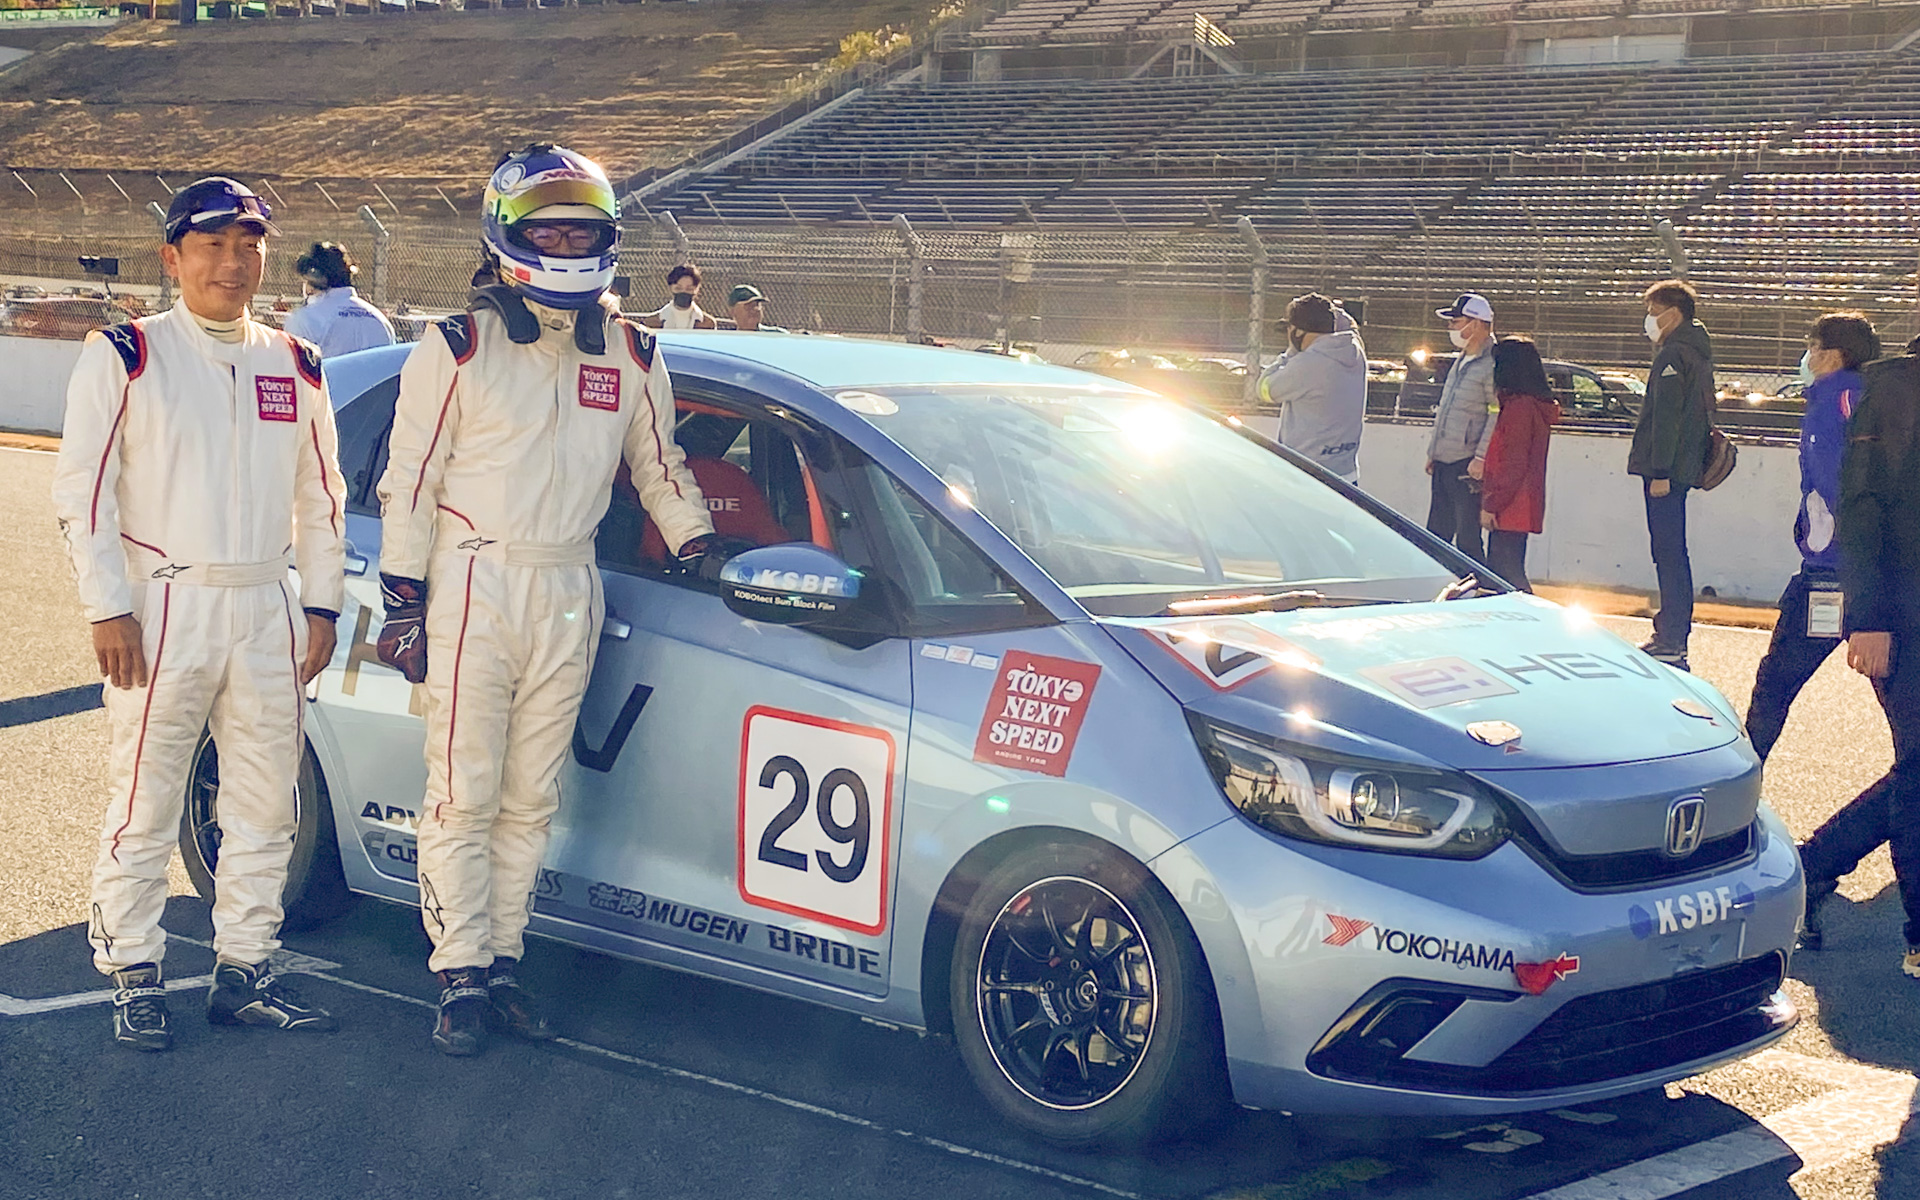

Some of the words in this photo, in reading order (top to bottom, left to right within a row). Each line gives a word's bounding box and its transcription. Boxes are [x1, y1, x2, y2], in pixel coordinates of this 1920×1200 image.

[262, 391, 292, 403] NEXT
[582, 390, 616, 404] SPEED
[585, 380, 615, 393] NEXT
[260, 402, 294, 414] SPEED
[758, 568, 838, 594] KSBF
[775, 596, 792, 606] Sun
[793, 598, 817, 609] Block
[818, 602, 836, 611] Film
[1006, 667, 1084, 702] TOKYO
[1481, 652, 1660, 685] HEV
[1000, 695, 1071, 728] NEXT
[988, 719, 1065, 755] SPEED
[360, 801, 420, 830] ADV
[758, 754, 871, 883] 29
[648, 899, 749, 944] MUGEN
[1655, 886, 1732, 935] KSBF
[765, 923, 882, 978] BRIDE
[1373, 925, 1515, 974] YOKOHAMA
